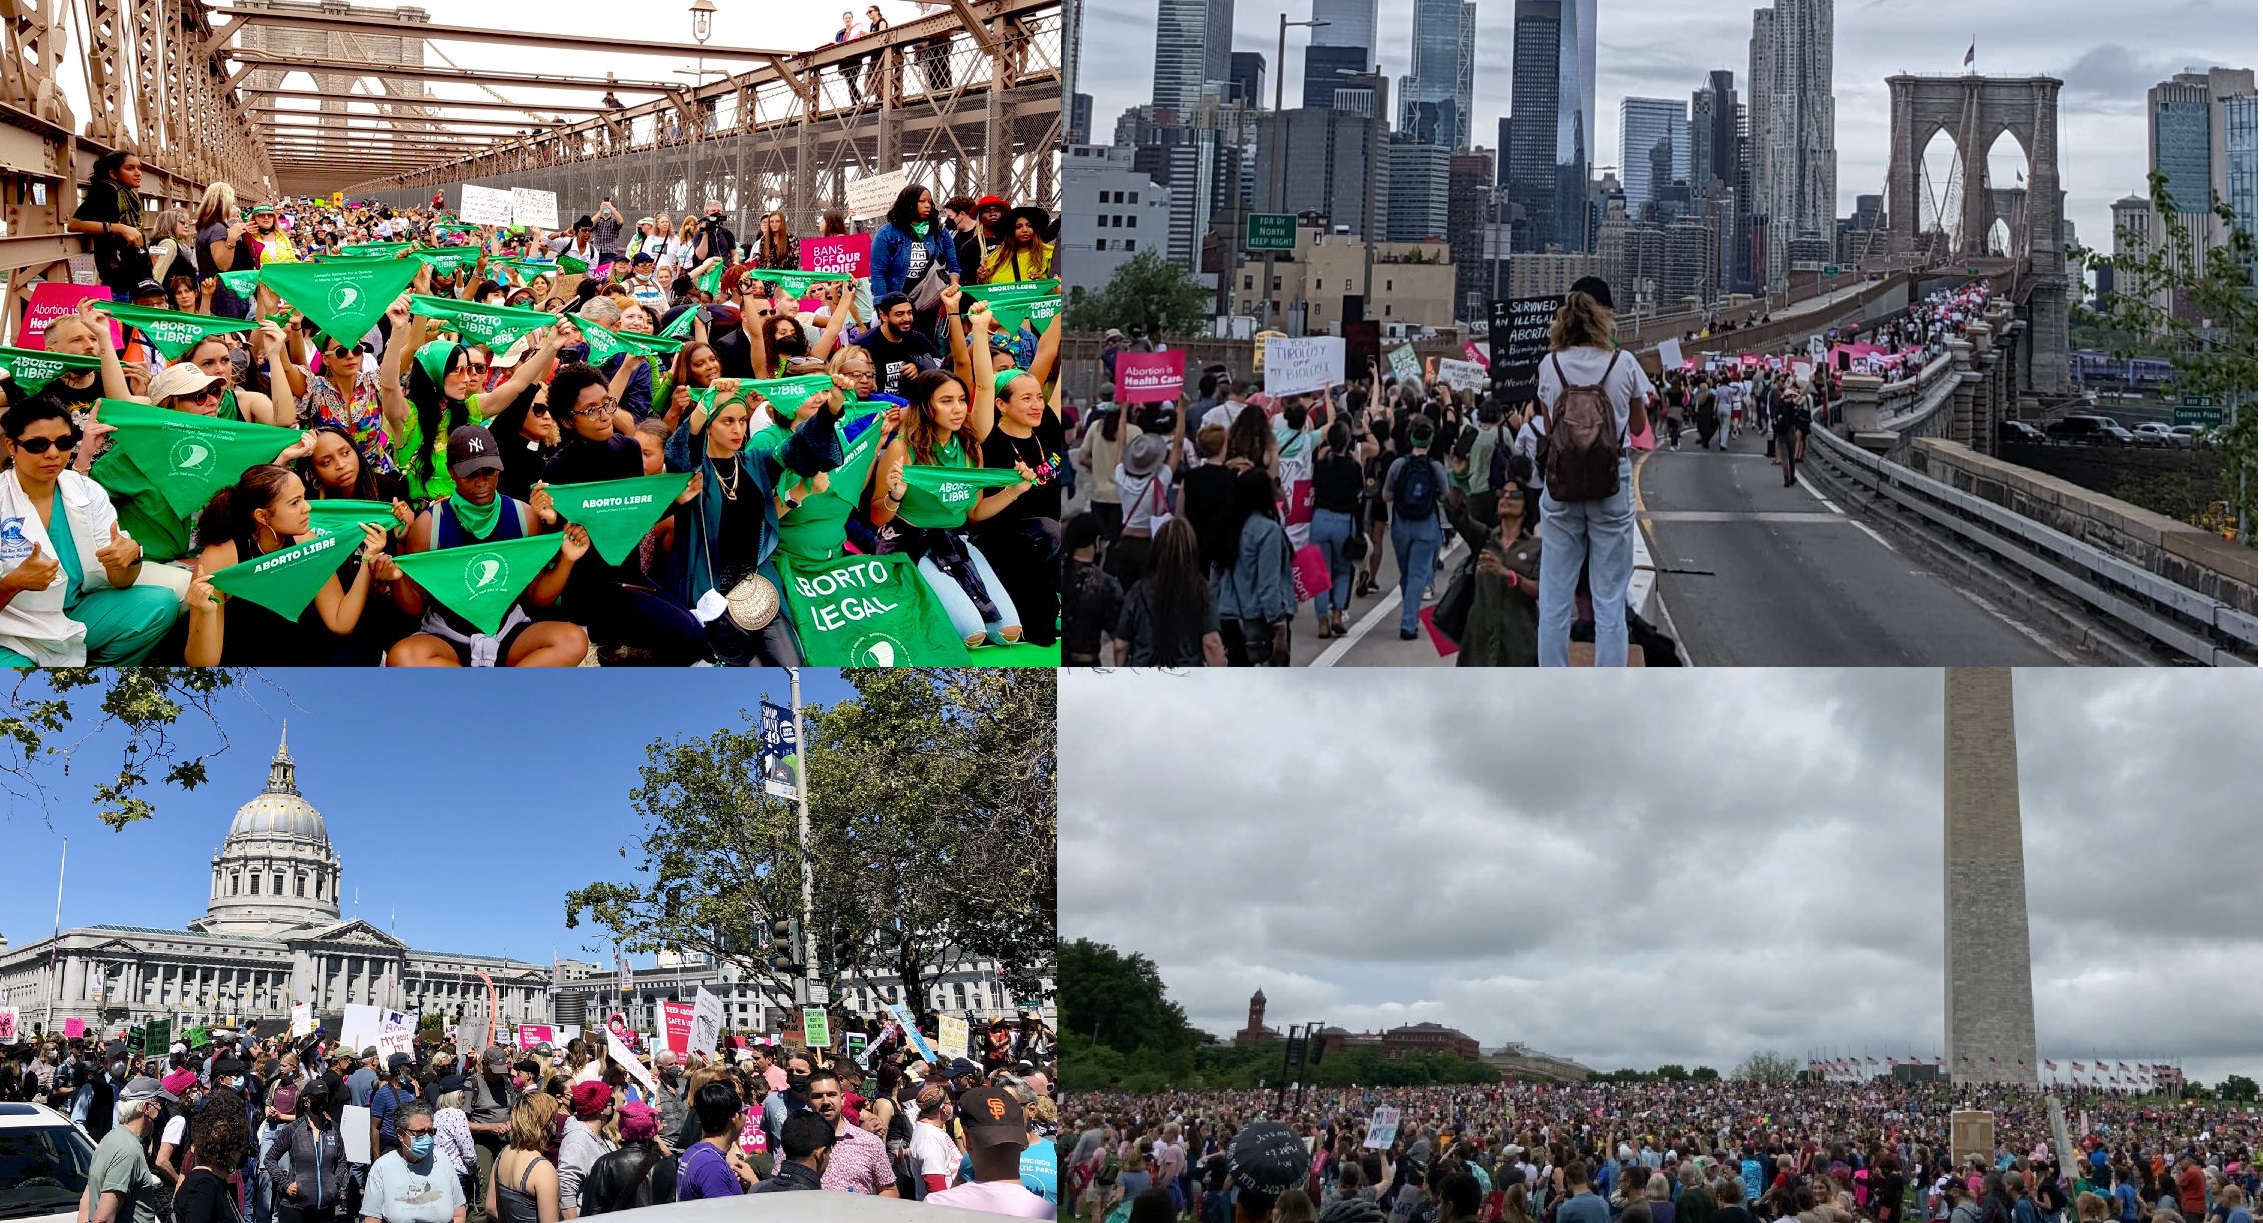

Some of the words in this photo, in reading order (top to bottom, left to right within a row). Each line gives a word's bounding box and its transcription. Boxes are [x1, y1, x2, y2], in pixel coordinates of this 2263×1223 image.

[1260, 216, 1274, 225] FDR
[1276, 217, 1286, 225] Dr
[1259, 227, 1285, 236] NORTH
[1250, 237, 1269, 245] KEEP
[1271, 237, 1293, 246] RIGHT
[814, 244, 844, 257] BANS
[814, 256, 835, 267] OFF
[837, 252, 860, 264] OUR
[592, 269, 610, 281] ANS
[784, 281, 805, 289] LIBRE
[988, 284, 1016, 293] ABORTO
[33, 303, 69, 315] Abortion
[1031, 308, 1055, 319] LIBRE
[1495, 302, 1505, 315] I
[1510, 300, 1558, 313] SURVIVED
[456, 313, 502, 327] ABORTO
[1495, 318, 1508, 327] AN
[1514, 314, 1557, 326] ILLEGAL
[149, 320, 203, 336] ABORTO
[458, 321, 494, 335] LIBRE
[1509, 326, 1552, 343] ABORTIO
[155, 331, 193, 345] LIBRE
[586, 326, 618, 347] ABORTO
[11, 356, 65, 371] ABORTO
[1293, 359, 1311, 368] OFF
[15, 367, 54, 380] LIBRE
[1125, 366, 1165, 376] Abortion
[1166, 365, 1173, 374] is
[1270, 367, 1282, 378] MY
[1124, 375, 1159, 386] Health
[769, 383, 807, 396] LIBRE
[2175, 410, 2201, 419] Cadman
[2202, 410, 2221, 419] Plaza
[468, 437, 484, 453] NY
[582, 497, 623, 509] ABORTO
[623, 494, 653, 505] LIBRE
[942, 490, 970, 503] LIBRE
[253, 549, 302, 574] ABORTO
[302, 537, 336, 557] LIBRE
[810, 596, 899, 631] LEGAL
[764, 730, 780, 745] 49
[391, 1011, 404, 1025] MY
[380, 1035, 395, 1047] MY
[393, 1043, 405, 1053] MY
[739, 1134, 766, 1146] BOD
[1020, 1157, 1051, 1167] ANCISCO
